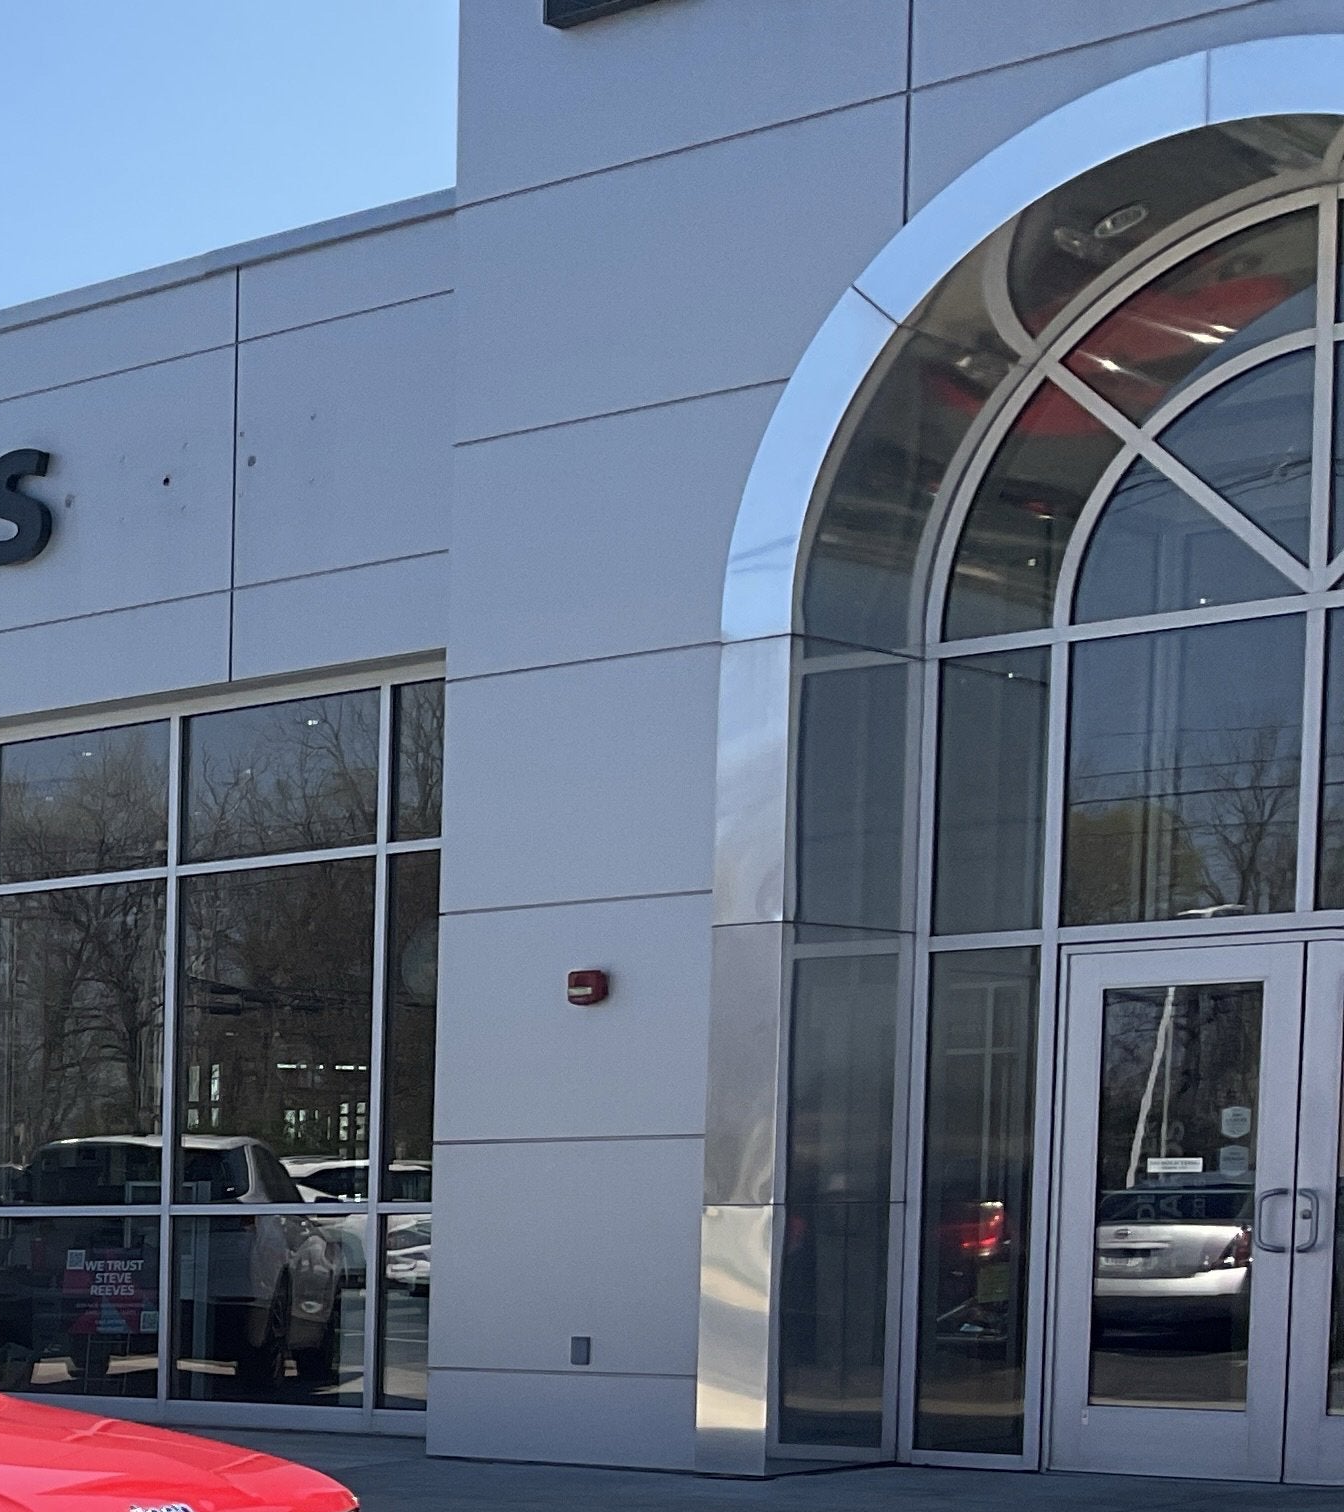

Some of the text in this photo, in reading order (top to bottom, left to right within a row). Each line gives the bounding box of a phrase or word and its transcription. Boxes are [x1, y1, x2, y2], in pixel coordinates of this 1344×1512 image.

[85, 1260, 144, 1271] WE TRUST
[95, 1273, 131, 1283] STEVE
[90, 1285, 135, 1295] REEVES
